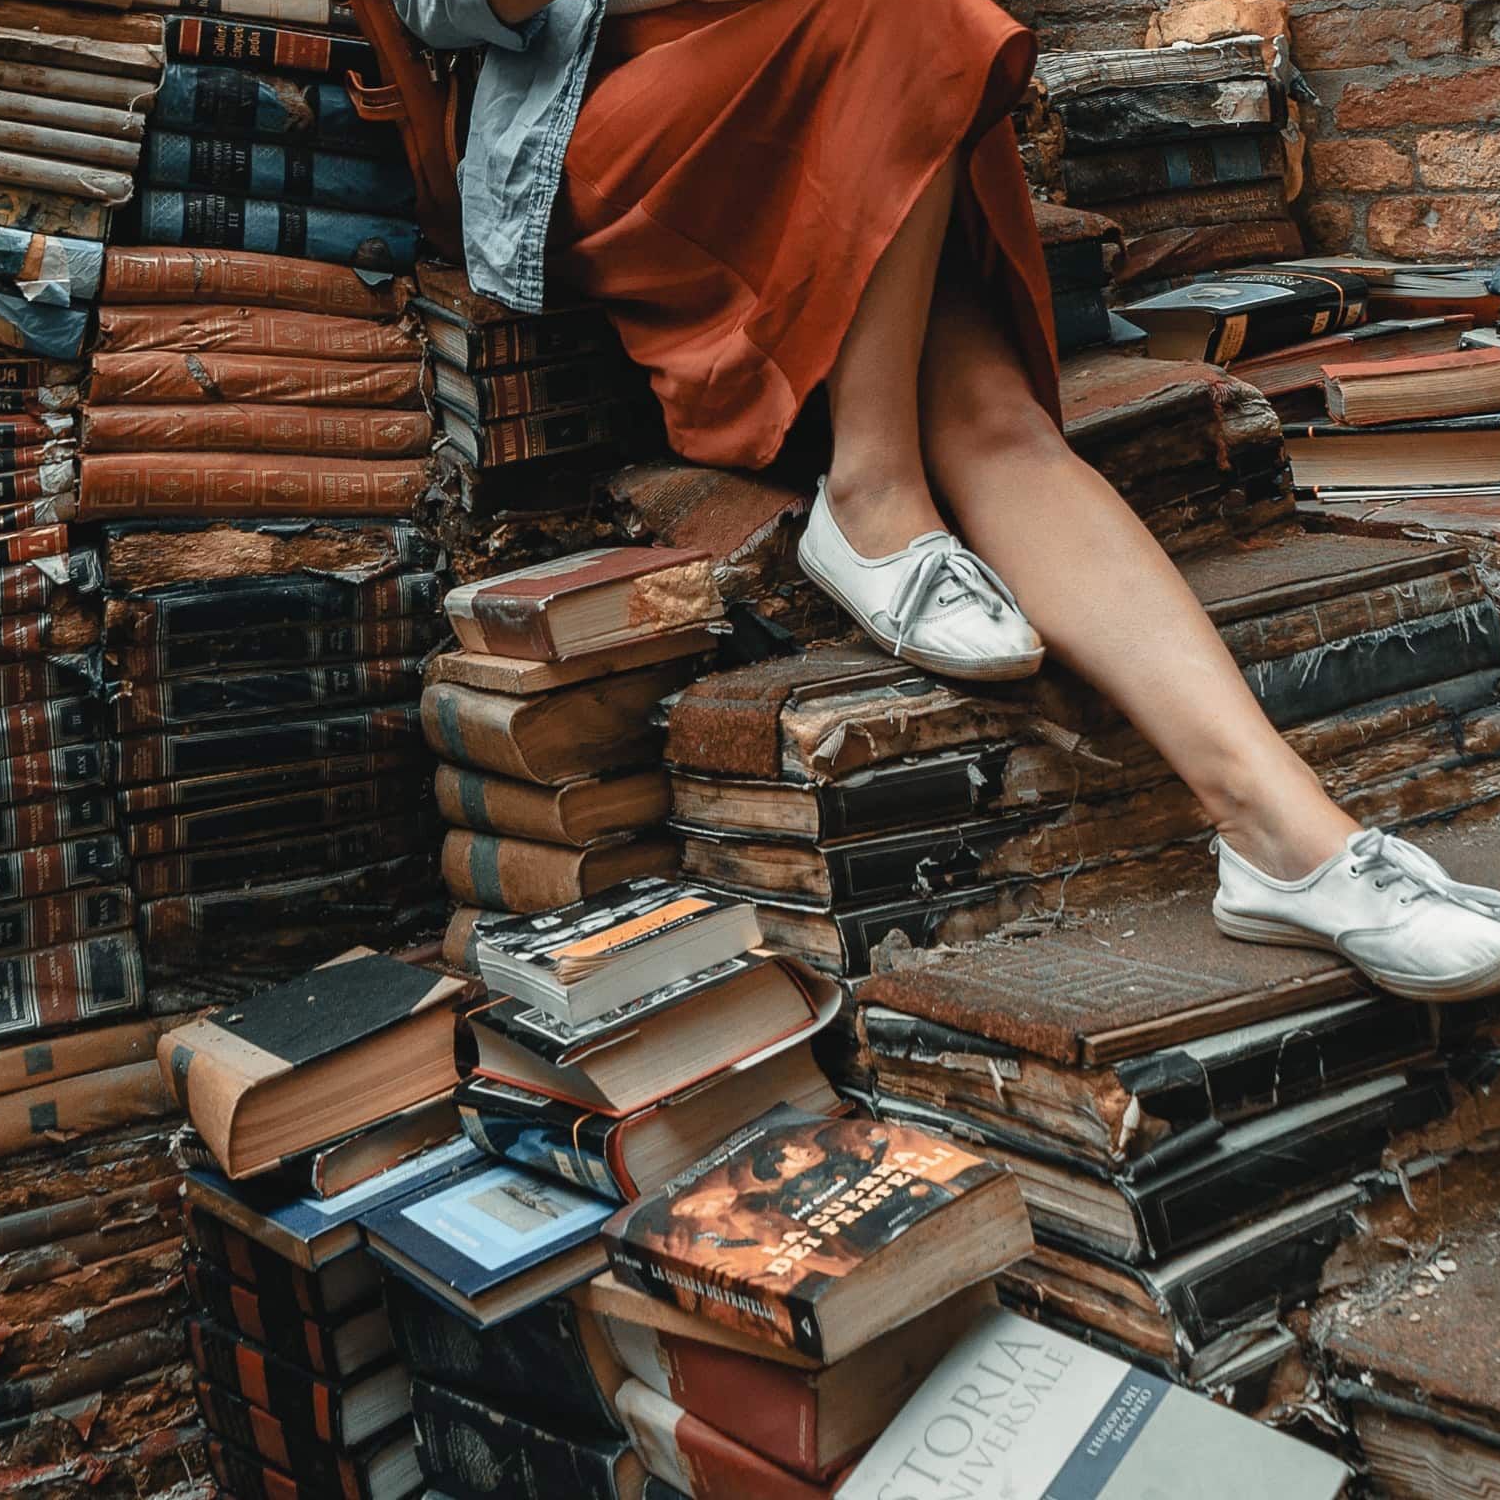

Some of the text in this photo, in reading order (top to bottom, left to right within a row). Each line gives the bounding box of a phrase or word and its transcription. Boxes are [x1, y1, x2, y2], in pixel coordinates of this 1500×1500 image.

[247, 31, 261, 57] pedia
[238, 324, 253, 337] III
[228, 482, 244, 494] V
[762, 1225, 813, 1257] LA
[802, 1146, 920, 1227] GUERRA
[765, 1225, 826, 1279] DEI
[818, 1145, 957, 1243] FRATELLI
[650, 1264, 775, 1321] LA GUERRA DEI FRATELLI
[1111, 1388, 1153, 1443] SEICENTO
